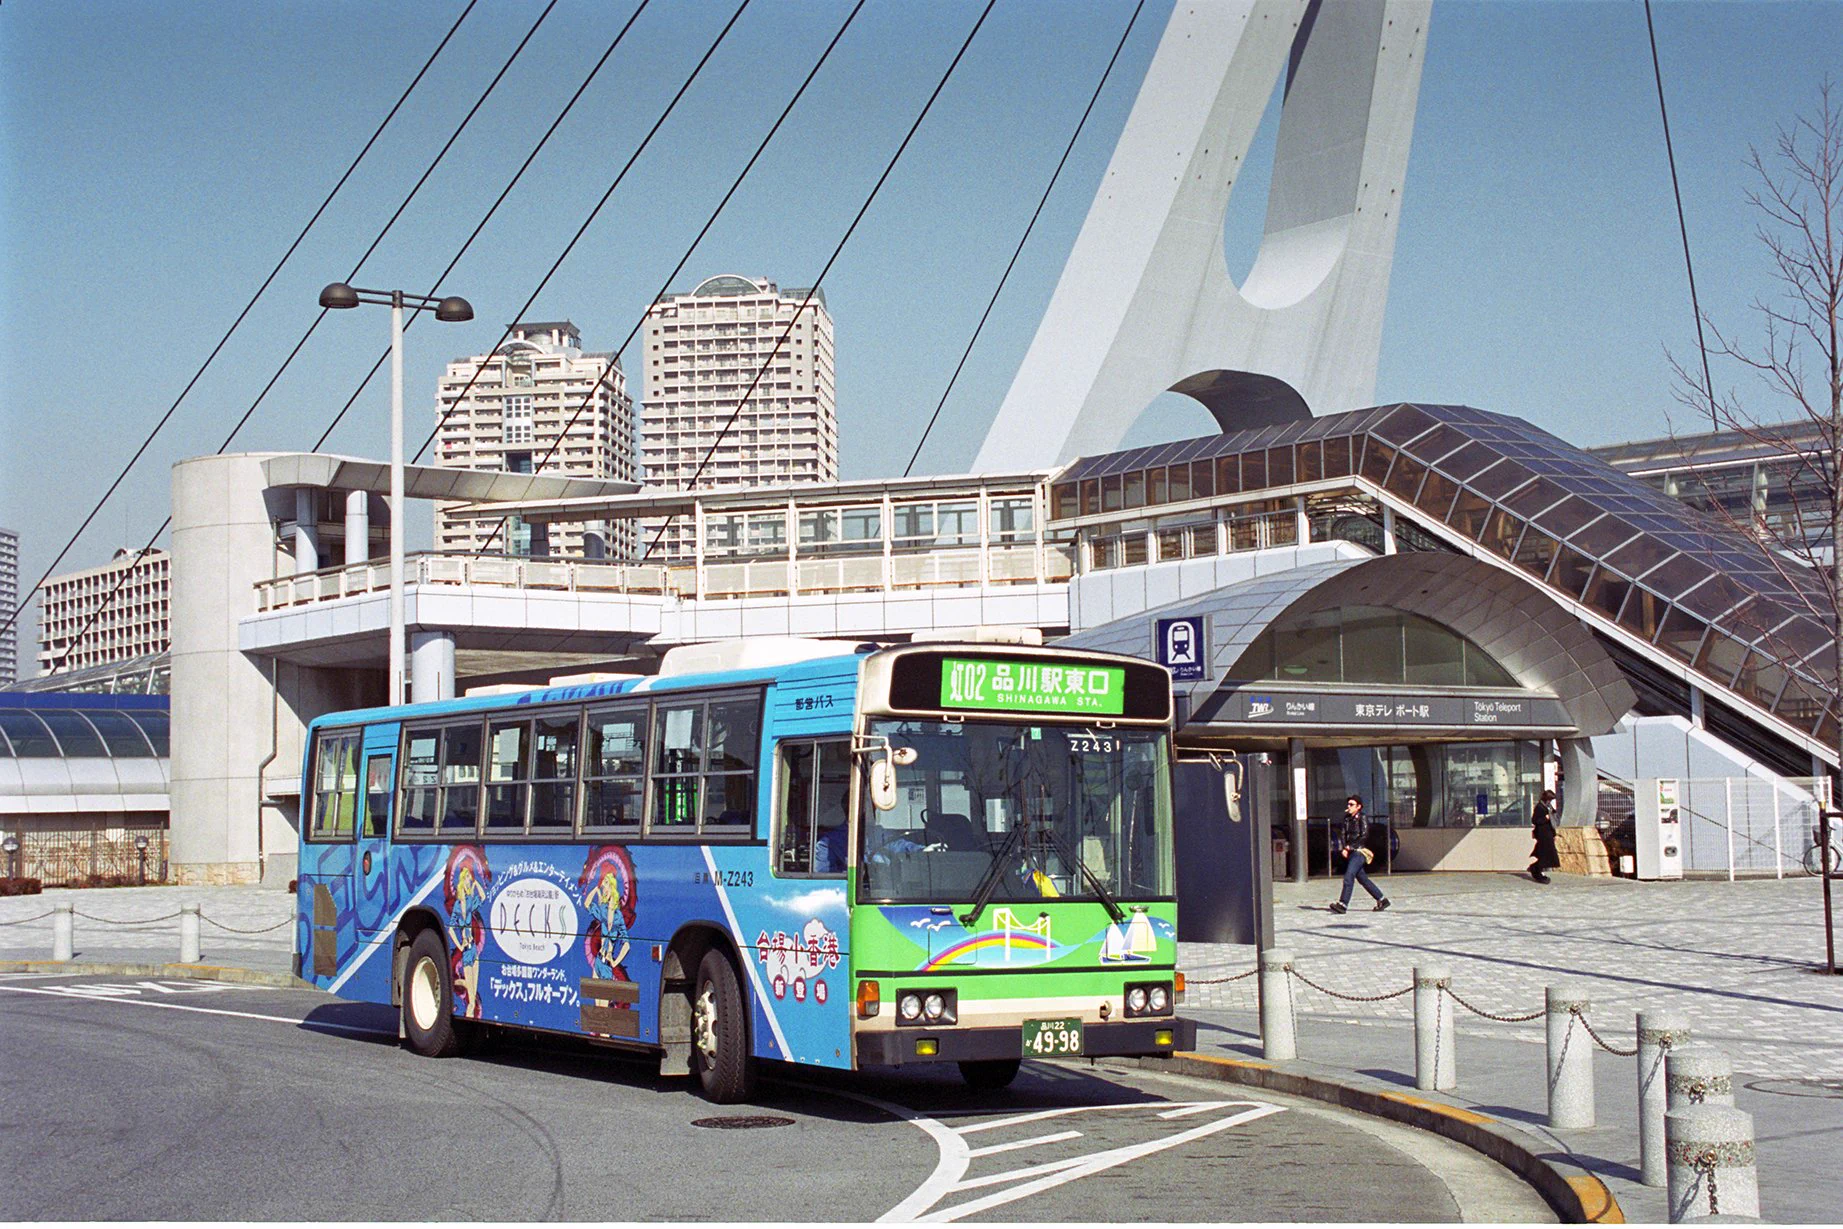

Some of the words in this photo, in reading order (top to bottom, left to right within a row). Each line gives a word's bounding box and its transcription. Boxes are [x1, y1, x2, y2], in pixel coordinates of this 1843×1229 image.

[992, 664, 1109, 695] 品川駅東口
[997, 693, 1067, 705] SHINAGAWA
[1077, 697, 1103, 707] STA.
[1495, 702, 1521, 713] Teleport
[1474, 713, 1498, 722] Station
[500, 902, 567, 939] DECKS
